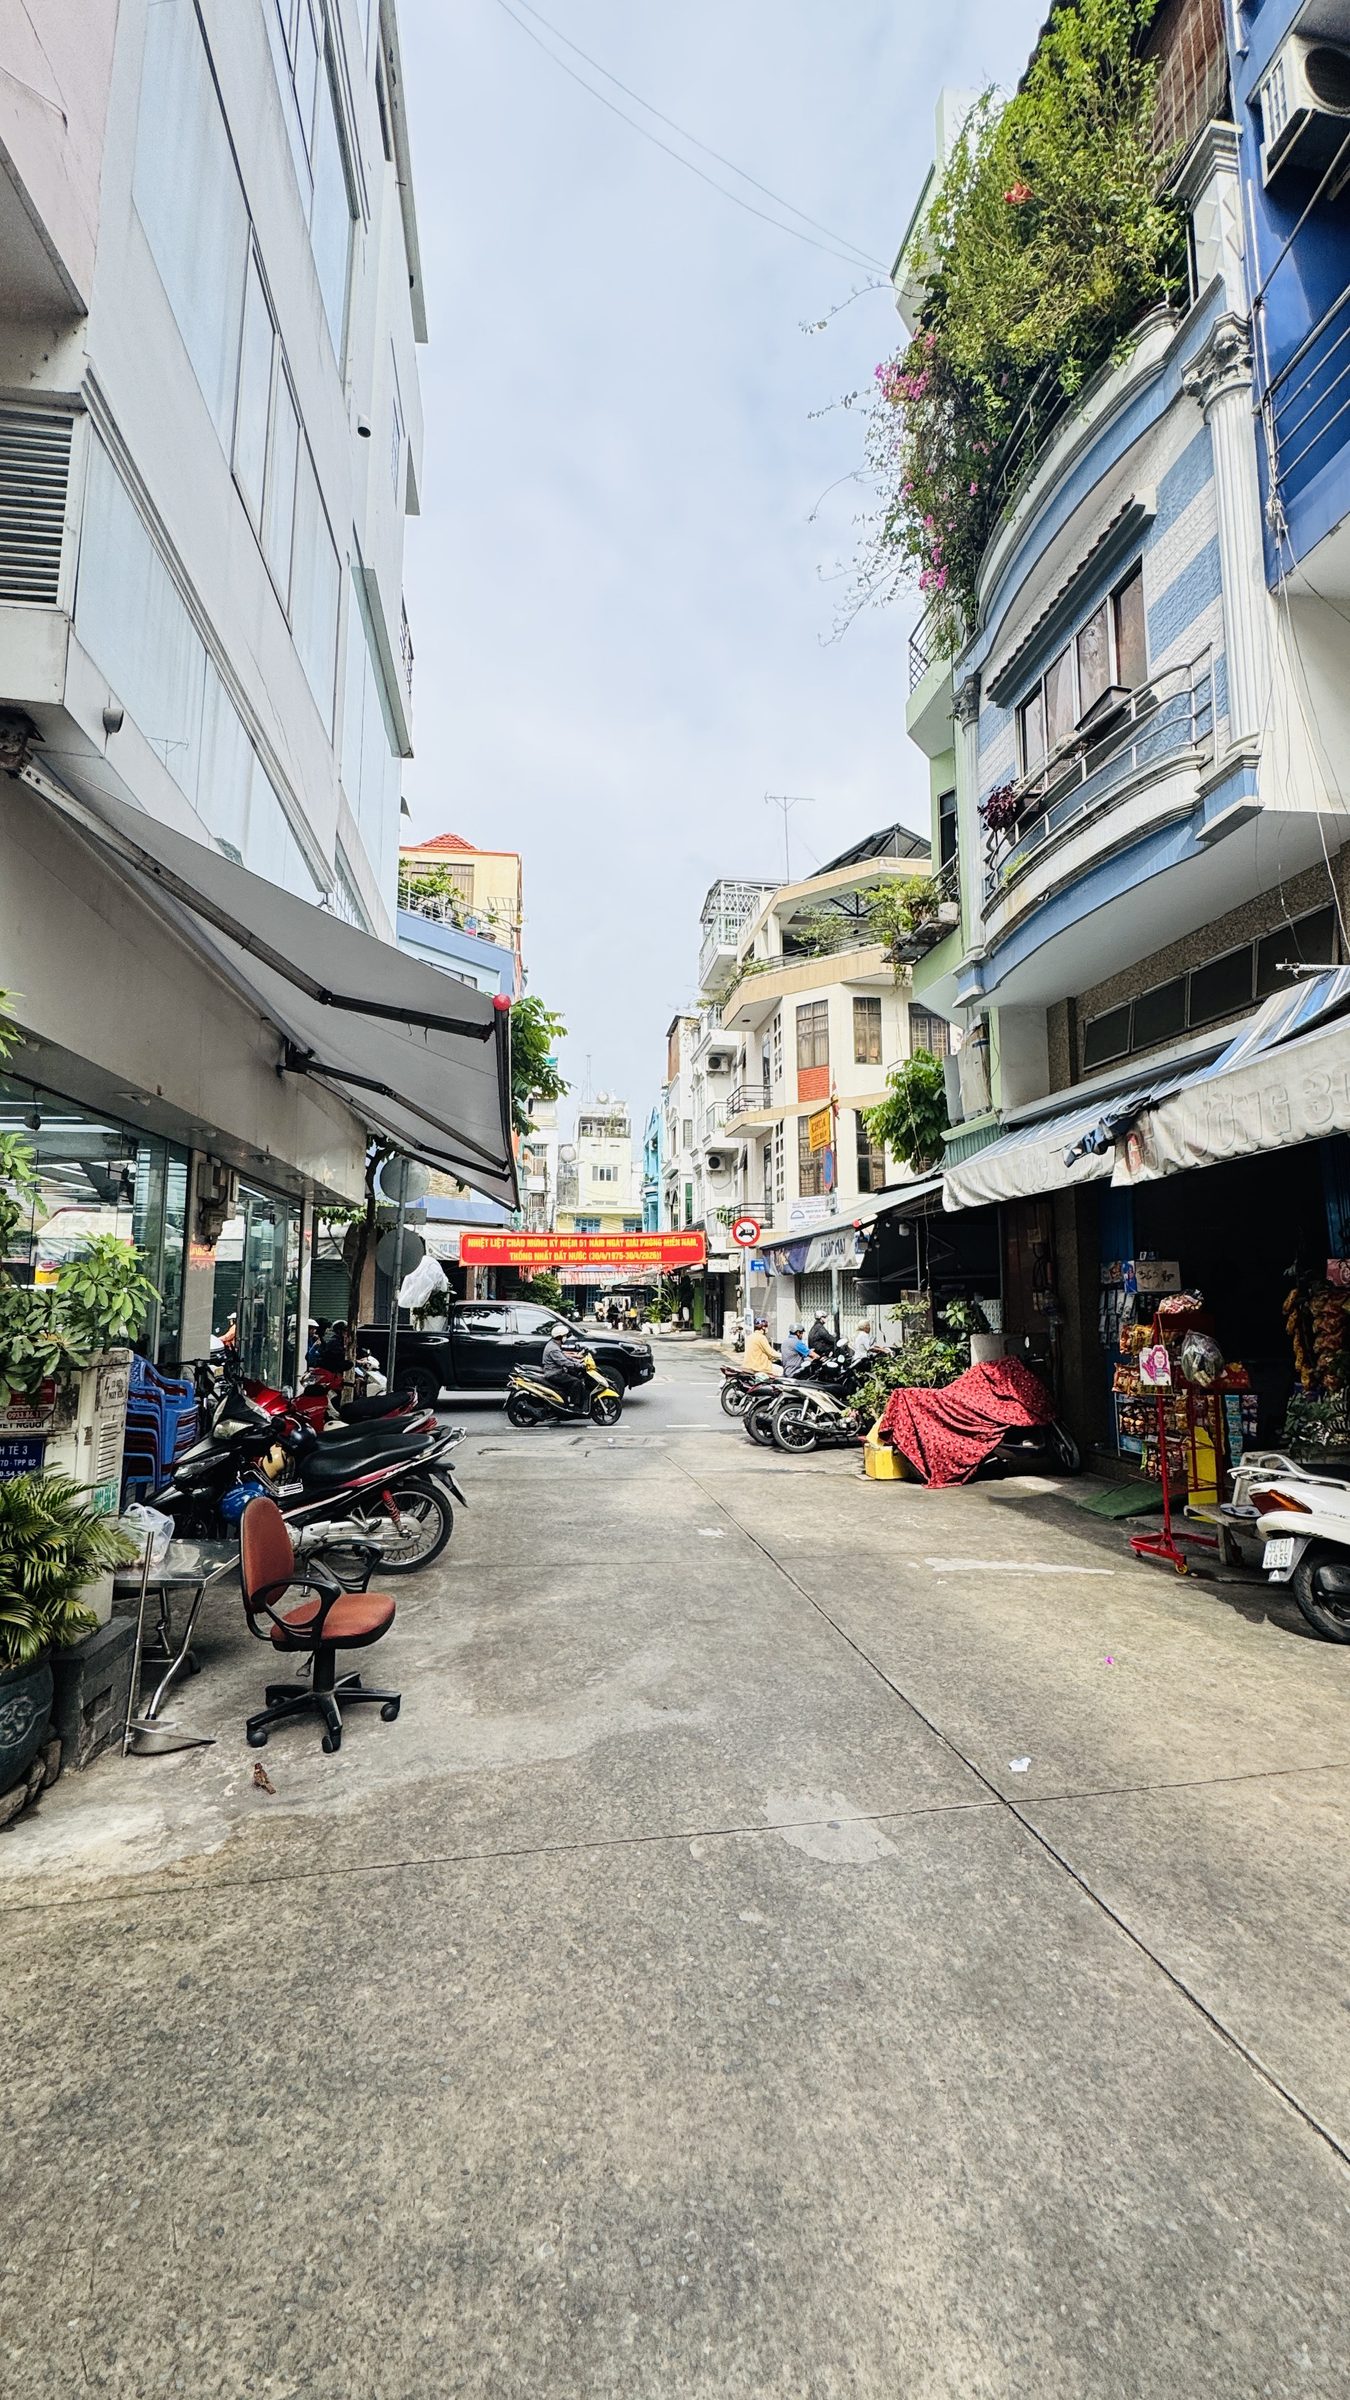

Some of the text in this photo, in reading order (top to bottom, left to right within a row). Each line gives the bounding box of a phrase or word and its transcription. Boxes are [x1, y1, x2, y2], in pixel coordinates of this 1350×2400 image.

[467, 1237, 489, 1249] NHIỆT
[490, 1237, 505, 1249] LIỆT
[506, 1236, 525, 1248] CHÀO
[526, 1237, 548, 1248] MỪNG
[549, 1235, 558, 1248] KỶ
[560, 1237, 578, 1249] NIỆM
[579, 1238, 587, 1248] 51
[589, 1237, 605, 1248] NĂM
[606, 1237, 624, 1248] NGÀY
[640, 1237, 662, 1247] PHÓNG
[663, 1236, 681, 1247] MIỀN
[509, 1250, 533, 1261] THỐNG
[534, 1250, 552, 1261] NHẤT
[553, 1251, 567, 1261] ĐẤT
[568, 1250, 587, 1261] NƯỚC
[22, 1445, 28, 1455] 3
